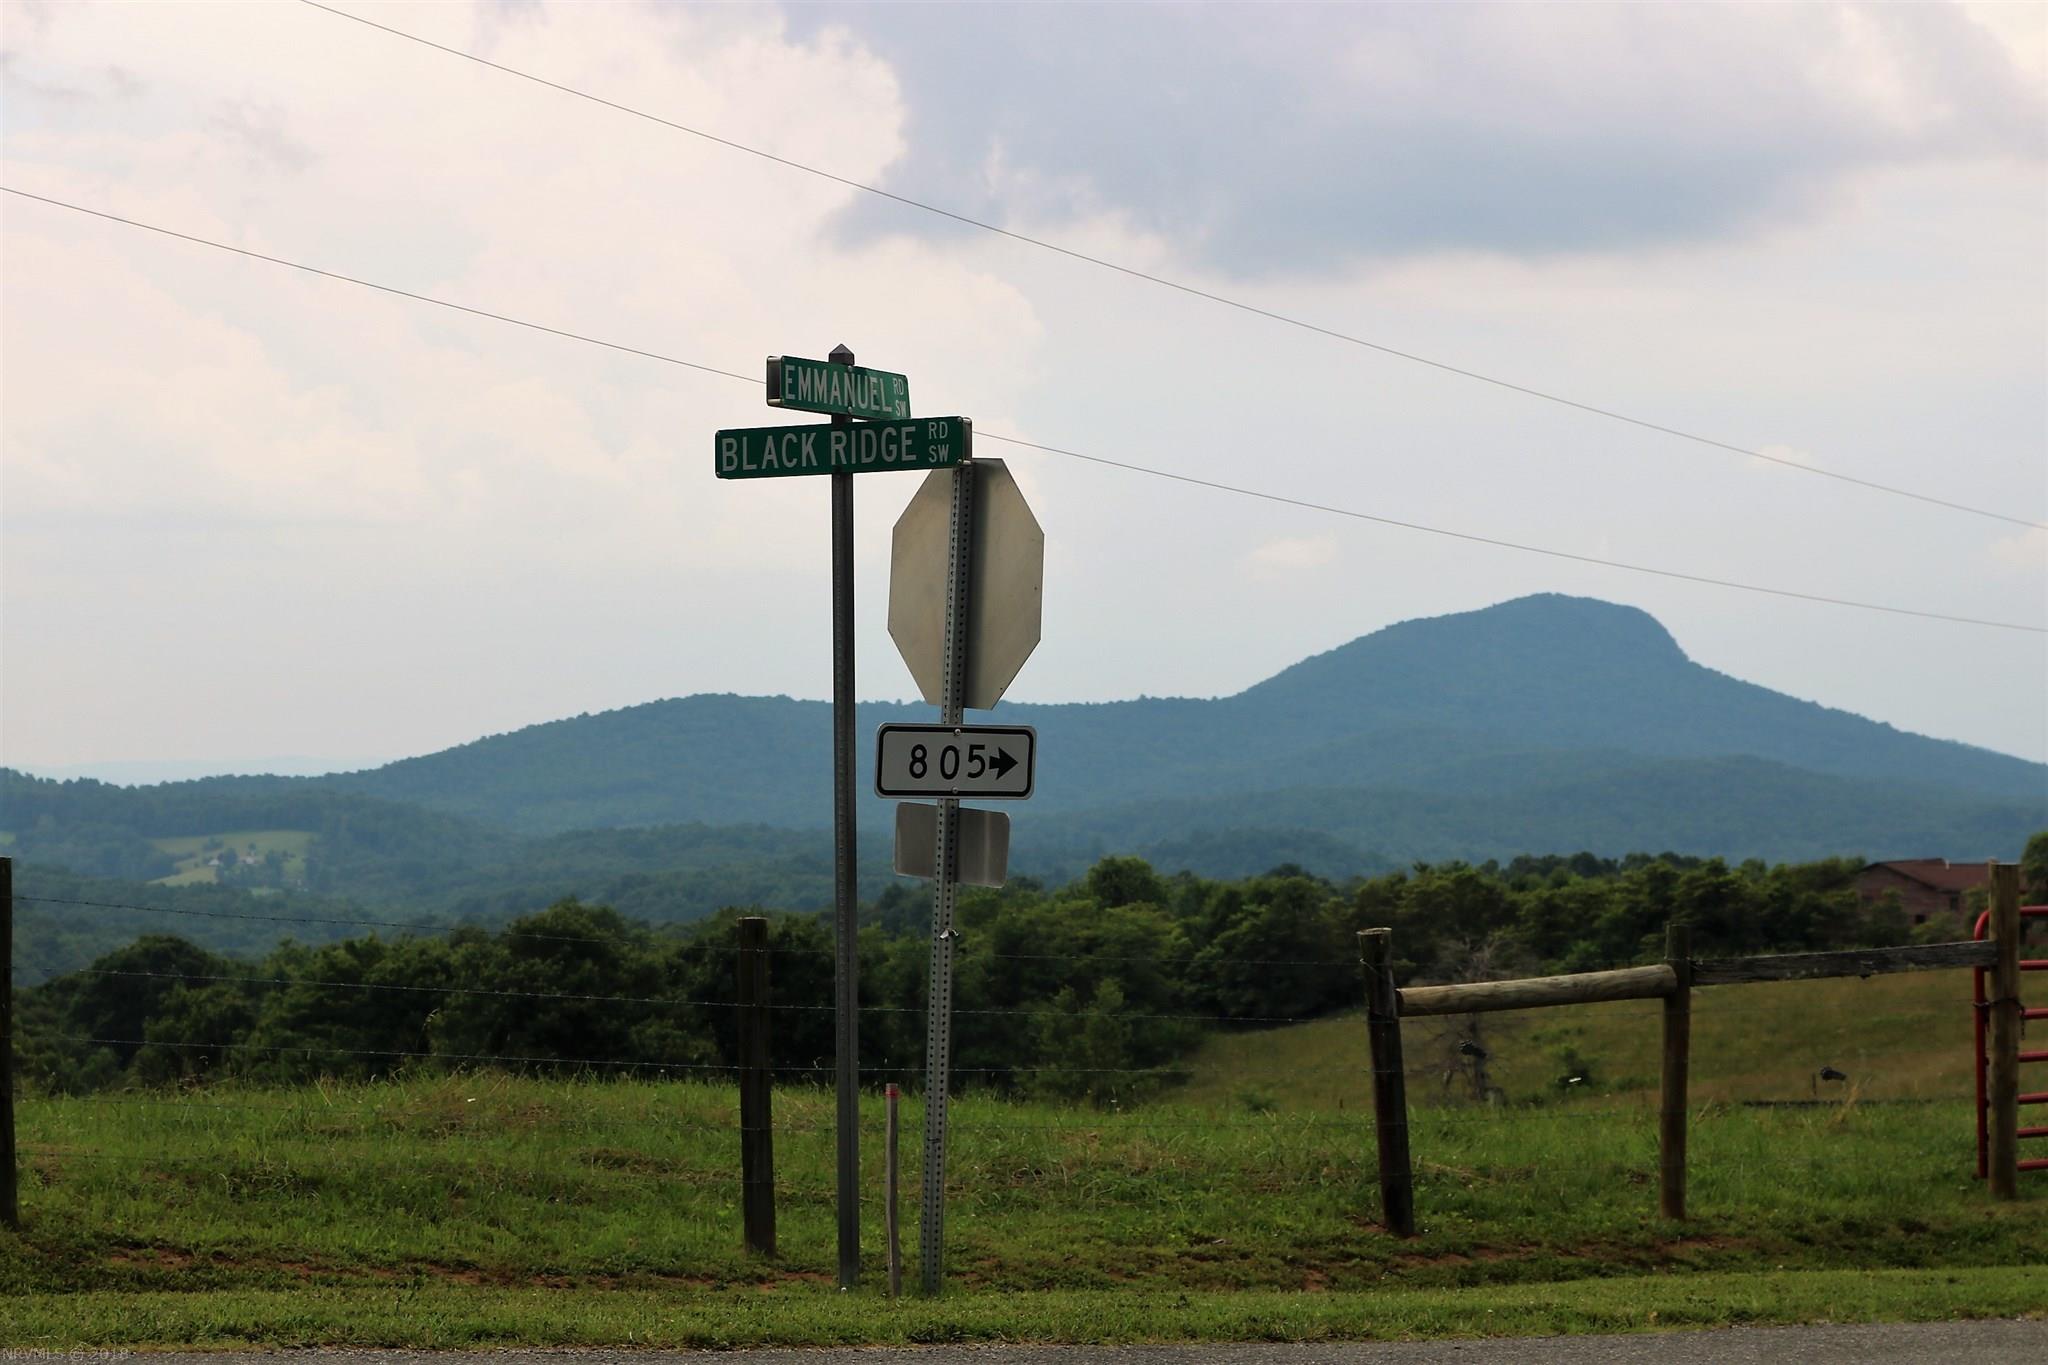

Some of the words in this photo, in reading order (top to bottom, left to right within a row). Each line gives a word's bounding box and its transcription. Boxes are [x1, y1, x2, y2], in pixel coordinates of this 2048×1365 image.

[784, 364, 893, 413] EMMANUEL
[892, 377, 904, 396] RD
[895, 399, 907, 418] SW
[928, 421, 948, 440] RD
[721, 432, 818, 472] BLACK
[830, 426, 917, 466] RIDGE
[928, 444, 949, 463] SW
[908, 743, 986, 780] 805
